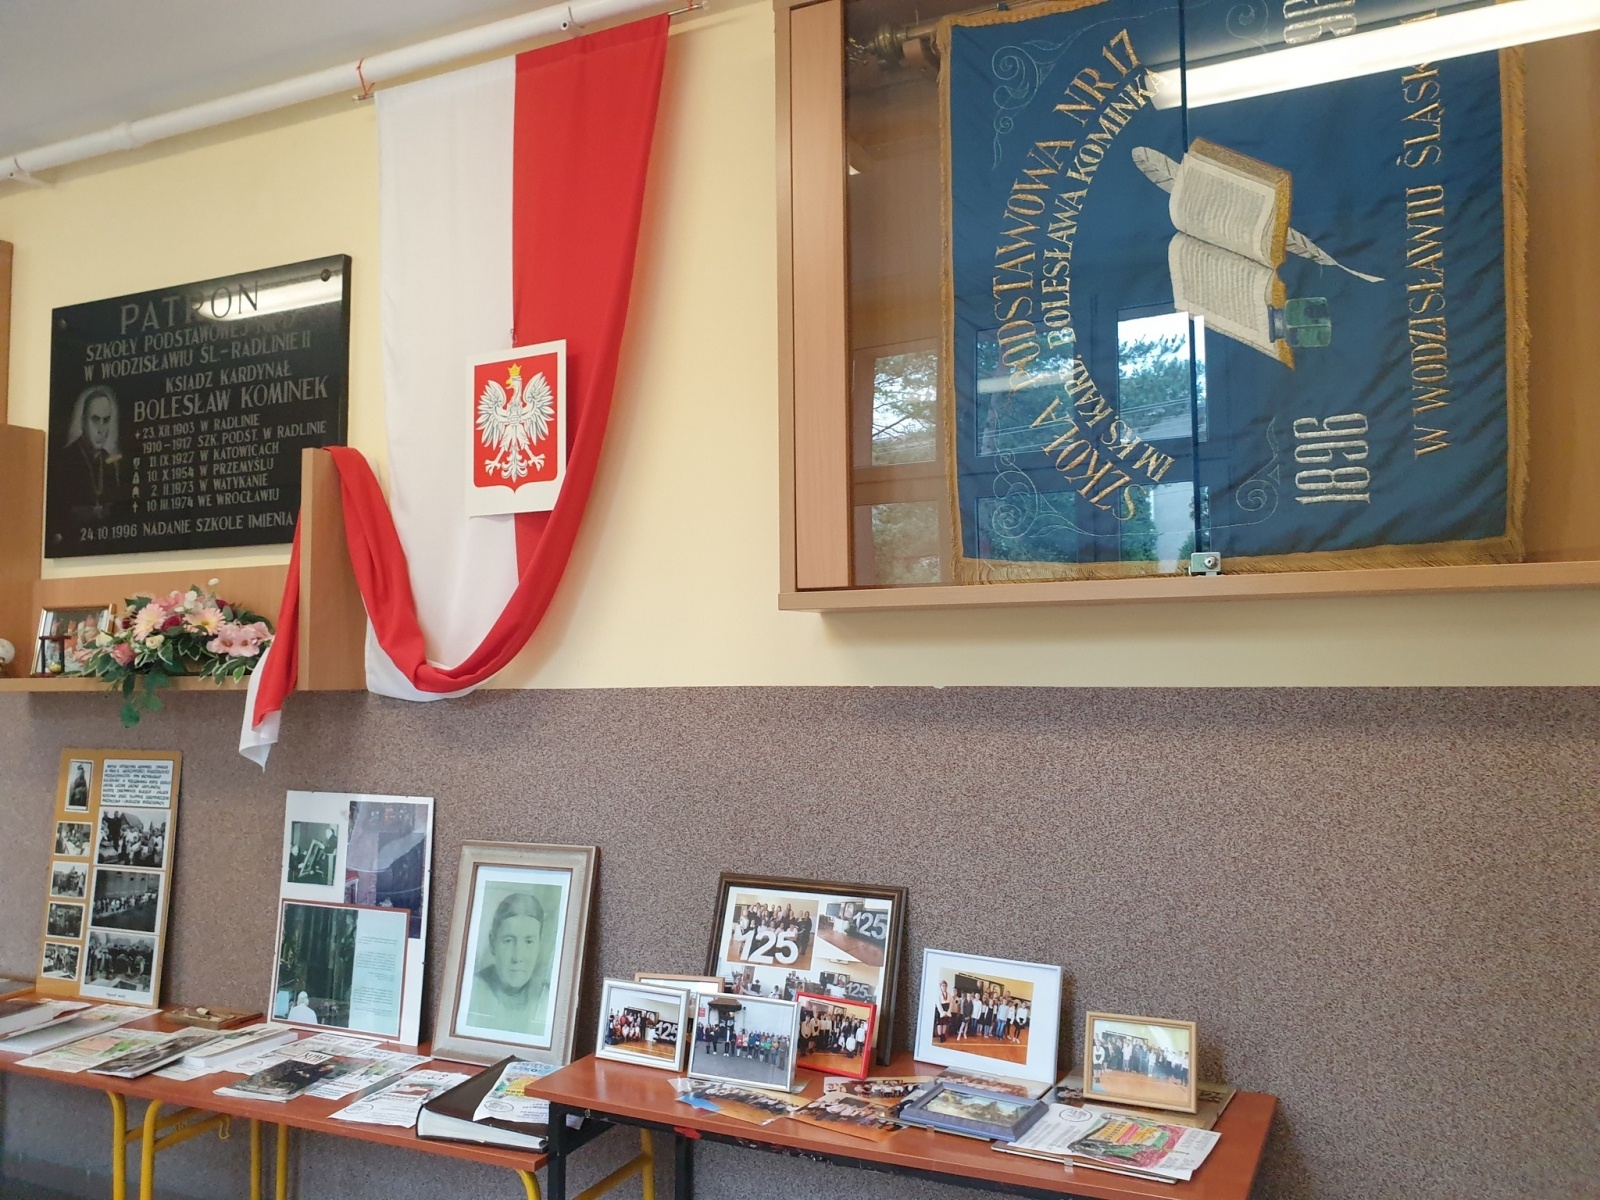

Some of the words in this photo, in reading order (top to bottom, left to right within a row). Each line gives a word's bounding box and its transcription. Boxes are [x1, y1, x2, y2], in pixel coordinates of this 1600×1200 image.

[1102, 28, 1140, 77] 17
[1052, 67, 1119, 127] NR
[1042, 188, 1088, 350] BOLESŁAWA
[1066, 68, 1169, 185] KOMINKA
[993, 139, 1077, 393] PODSTAWOWA
[120, 280, 259, 335] PATRON
[1405, 184, 1451, 417] WODZISŁAWIU
[84, 364, 95, 382] W
[101, 349, 194, 379] WODZISŁAWIU
[302, 330, 311, 348] II
[86, 337, 138, 361] SZKOŁY
[220, 360, 292, 386] KARDYNAŁ
[133, 389, 231, 423] BOLESŁAW
[241, 375, 329, 409] KOMINEK
[200, 420, 209, 432] W
[213, 413, 260, 431] RADLINIE
[263, 427, 272, 440] W
[277, 420, 327, 438] RADLINIE
[200, 450, 209, 461] W
[213, 441, 280, 461] KATOWICACH
[1413, 424, 1451, 460] W
[200, 464, 208, 476] W
[213, 456, 274, 475] PRZEMYŚLU
[1030, 396, 1147, 521] SZKOŁA
[1292, 413, 1371, 504] 1896
[197, 495, 212, 507] WE
[216, 488, 280, 505] WROCŁAWIU
[199, 479, 208, 492] W
[213, 473, 268, 491] WATYKANIE
[143, 520, 191, 537] NADANIE
[196, 515, 243, 532] SZKOLE
[248, 511, 294, 529] IMIENIA
[853, 911, 889, 940] 125
[739, 930, 799, 965] 125
[845, 981, 870, 998] 125
[654, 1021, 679, 1042] 125
